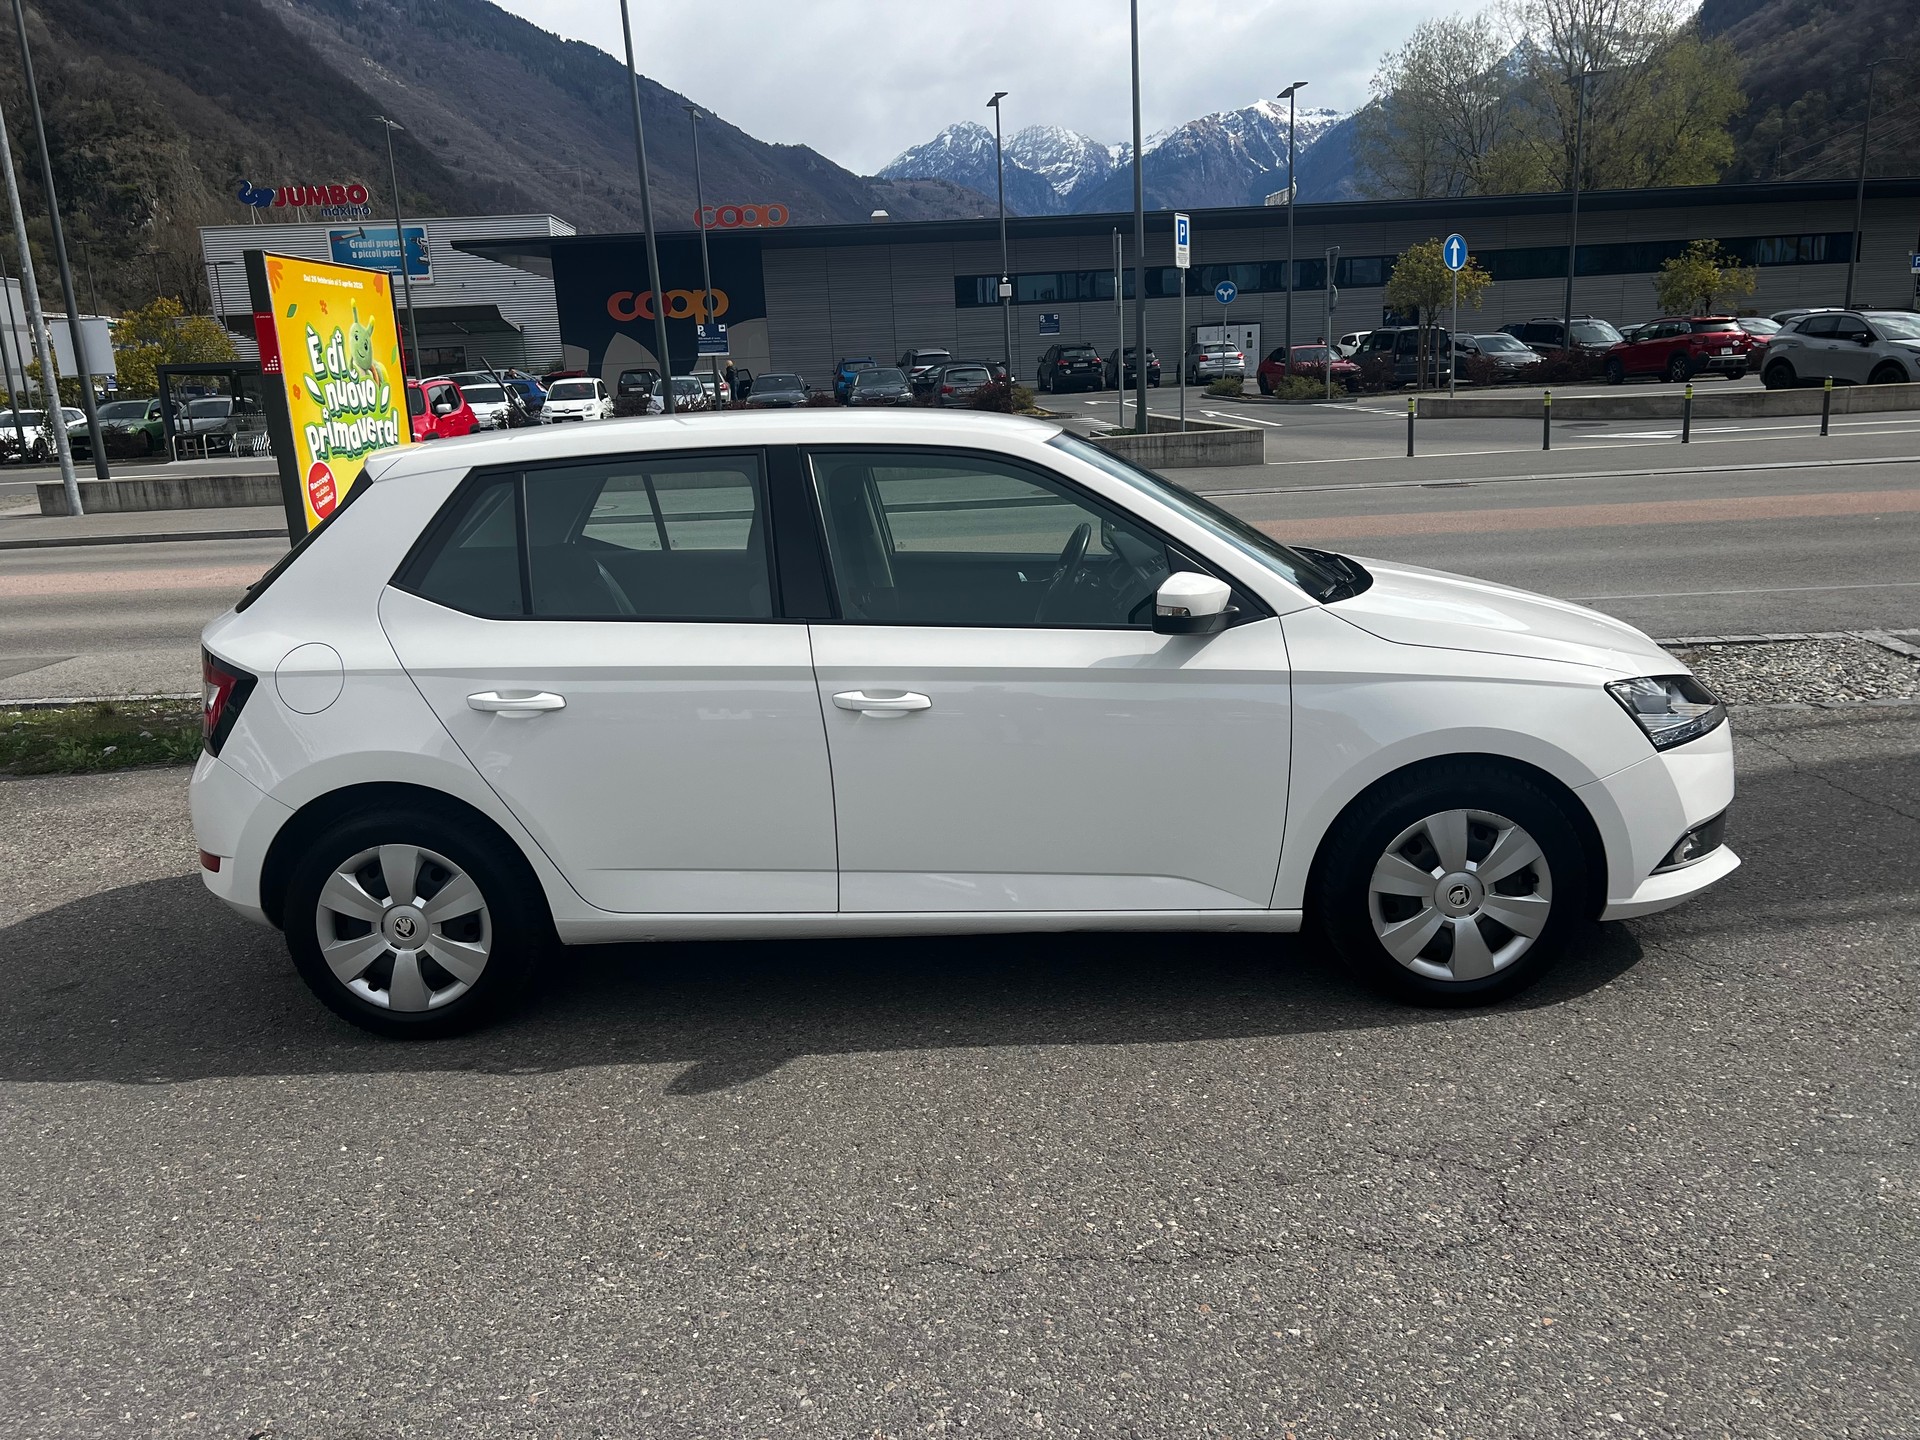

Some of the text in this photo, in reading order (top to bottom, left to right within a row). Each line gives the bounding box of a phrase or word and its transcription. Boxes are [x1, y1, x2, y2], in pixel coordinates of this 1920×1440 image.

[274, 184, 369, 207] JUMBO
[321, 206, 372, 217] maximo
[693, 204, 789, 229] coop
[349, 237, 406, 249] Grandi progeti
[352, 251, 357, 259] a
[358, 249, 382, 259] piccoli
[303, 274, 311, 282] Dal
[317, 276, 335, 286] febbraio
[342, 280, 353, 288] aprile
[607, 288, 729, 324] coop
[697, 324, 705, 336] P
[306, 325, 348, 376] È di
[324, 379, 377, 413] nuovo
[305, 407, 399, 461] primavera!
[310, 471, 331, 491] Raccogli
[315, 485, 330, 499] subito
